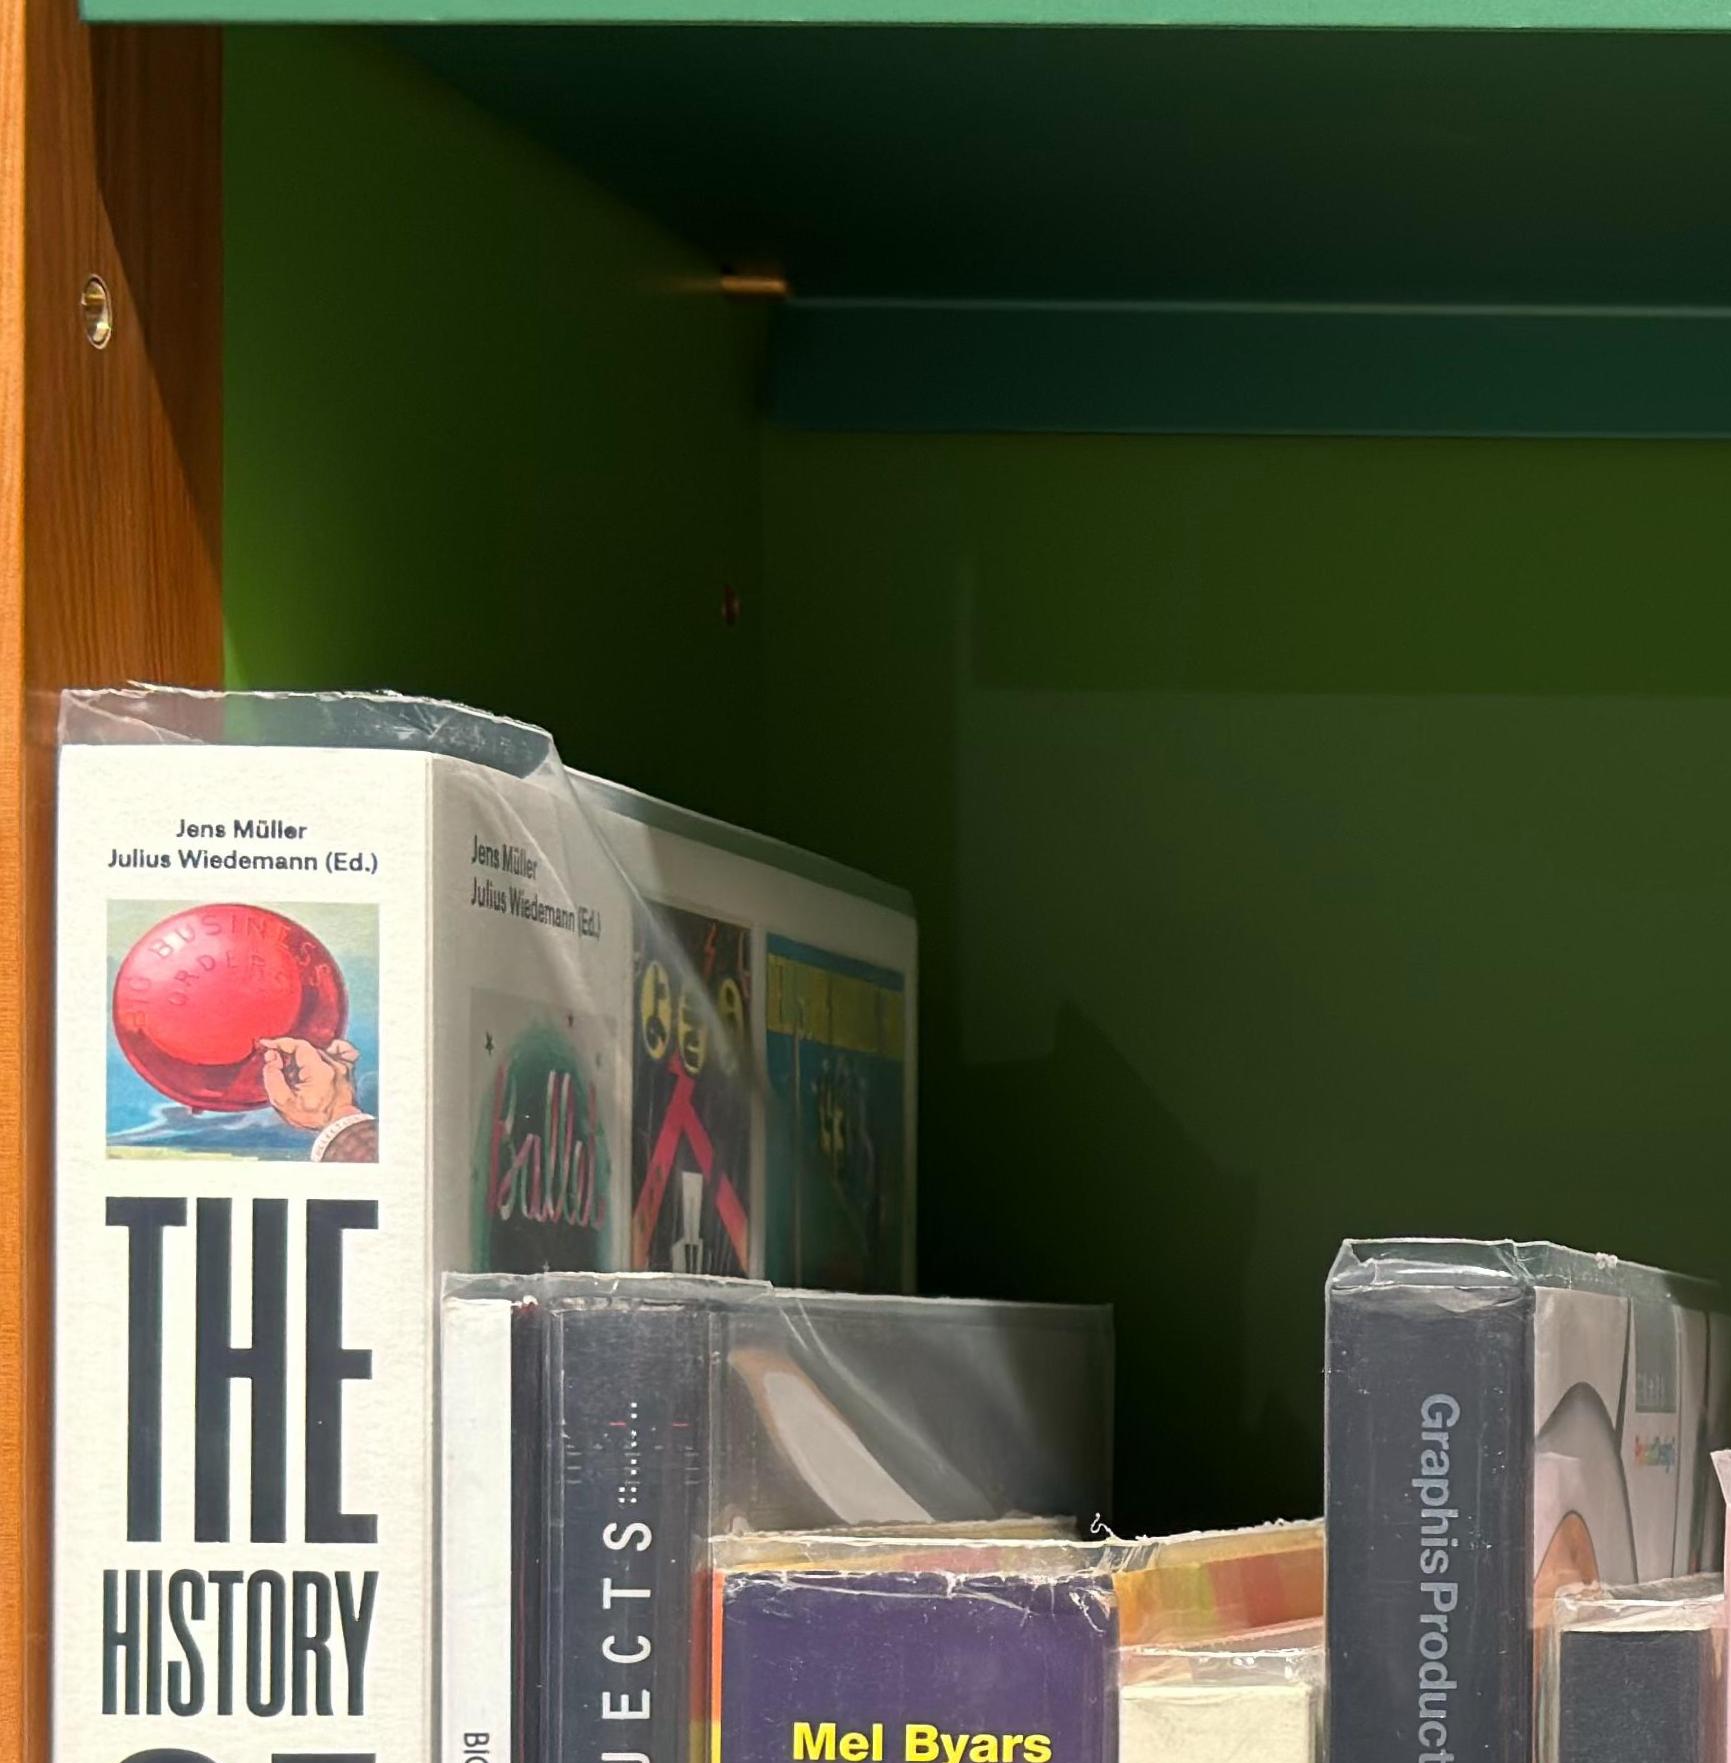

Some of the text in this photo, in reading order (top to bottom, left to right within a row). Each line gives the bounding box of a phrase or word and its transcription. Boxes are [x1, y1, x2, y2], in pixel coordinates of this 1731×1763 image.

[175, 816, 307, 839] Jens Müller
[108, 847, 378, 874] Julius Wiedemann (Ed.)
[471, 835, 538, 880] Jens Müller
[470, 877, 576, 931] Julius Wiedemann
[106, 1197, 378, 1543] THE
[103, 1569, 378, 1716] HISTORY
[792, 1722, 883, 1761] Mel
